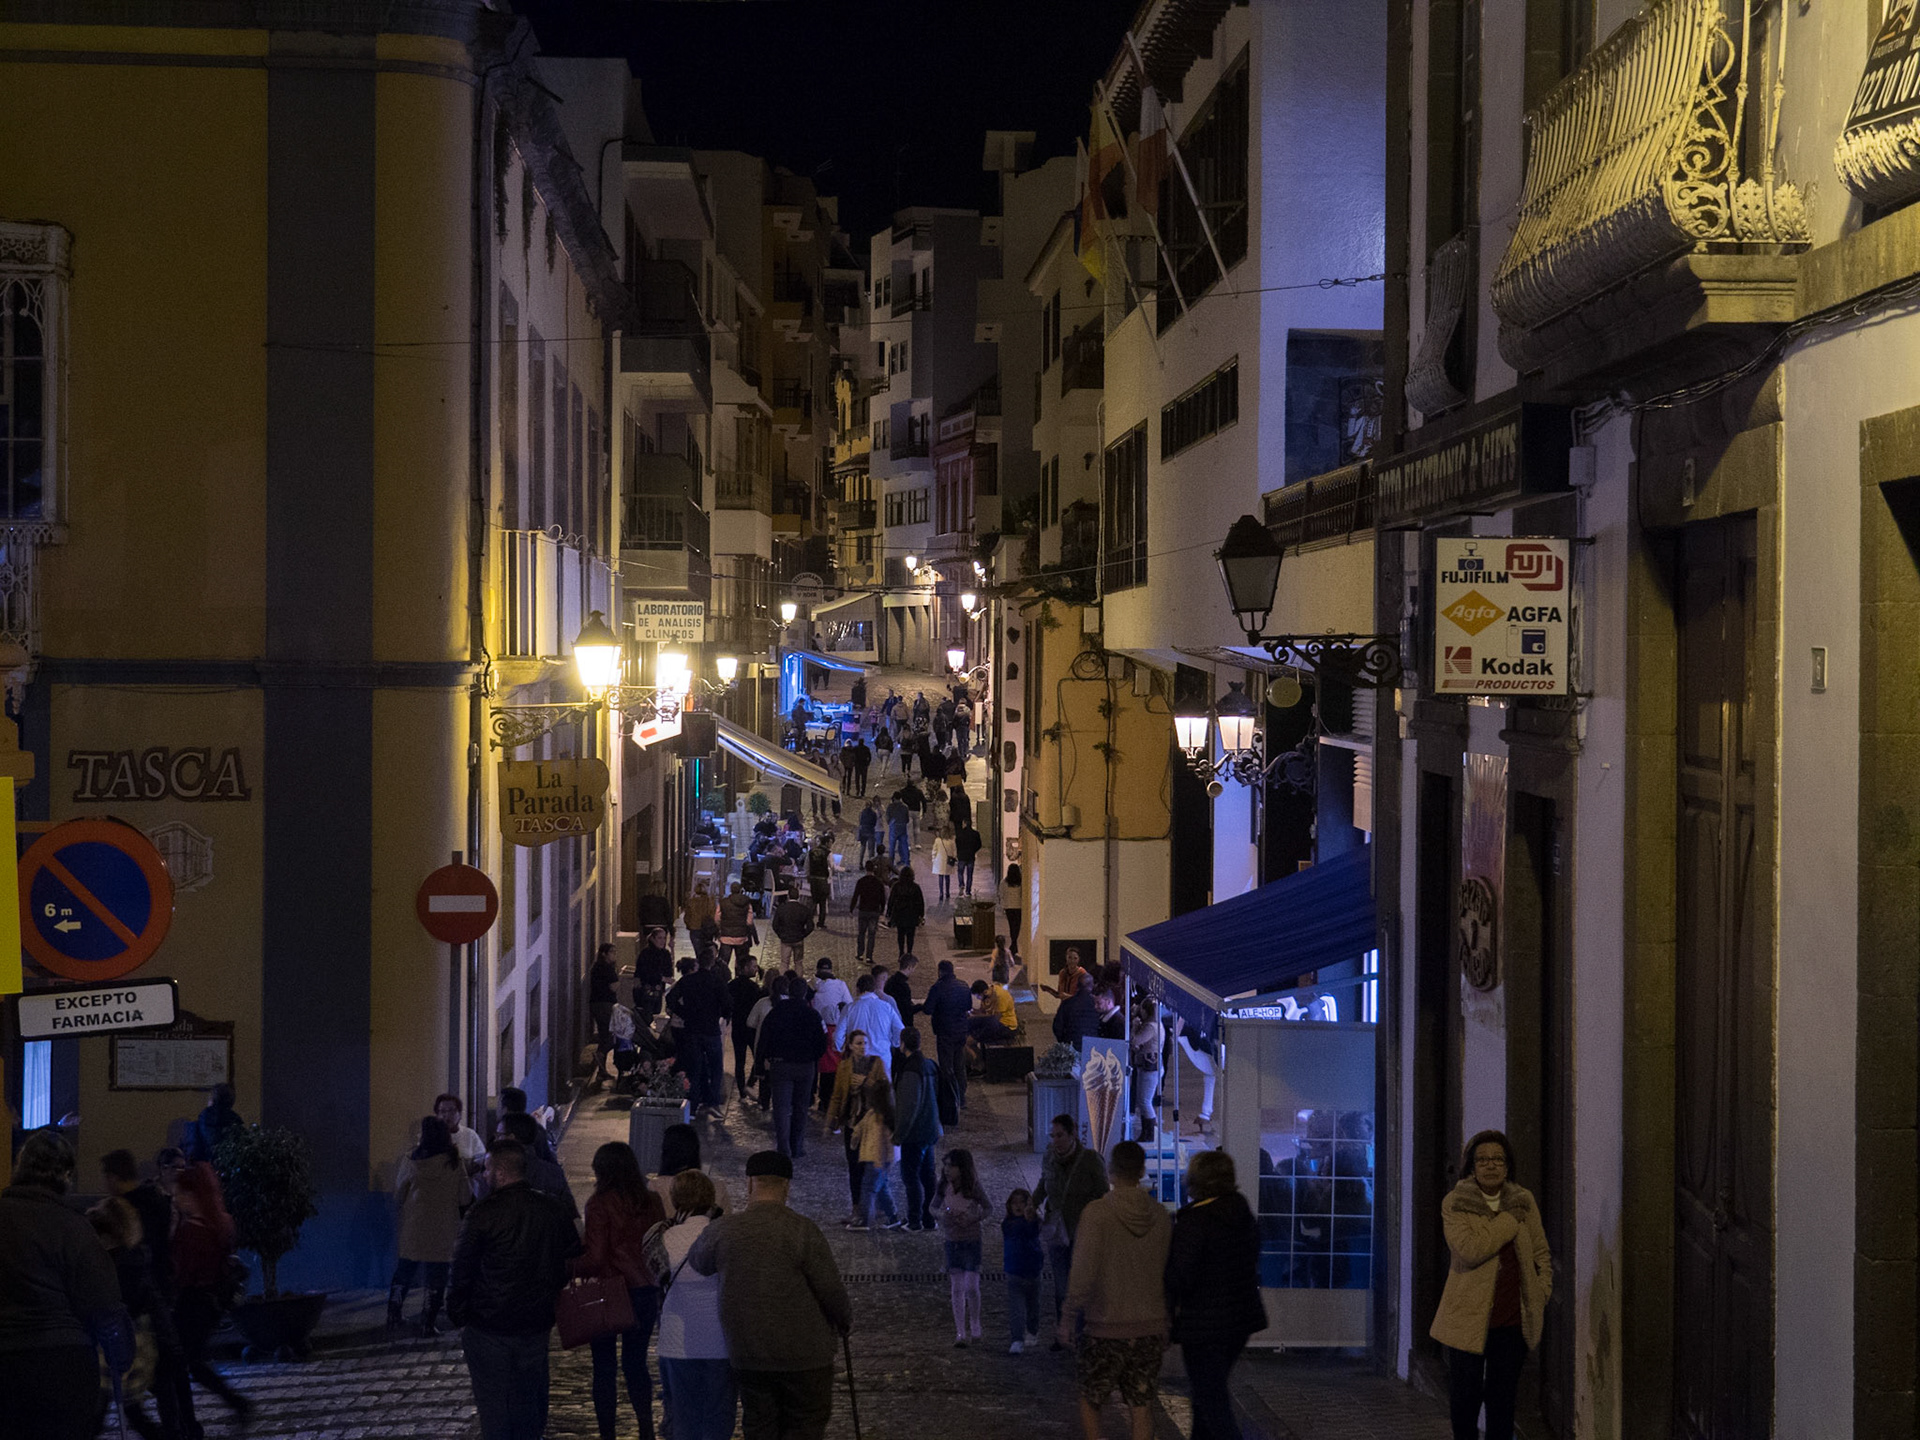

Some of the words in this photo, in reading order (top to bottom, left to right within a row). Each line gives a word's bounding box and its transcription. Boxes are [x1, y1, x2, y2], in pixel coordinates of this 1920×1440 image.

[1850, 67, 1885, 121] 922
[1875, 59, 1902, 111] 10
[1893, 50, 1920, 106] 10
[1378, 466, 1402, 517] FOTO
[1404, 442, 1466, 511] ELECTRONIC
[1469, 437, 1479, 495] &
[1481, 422, 1517, 489] GIFTS
[1441, 571, 1510, 584] FUJIFILM
[637, 604, 703, 616] LABORATORIO
[1449, 605, 1498, 622] Agfa
[1507, 606, 1562, 622] AGFA
[638, 618, 649, 627] DE
[658, 618, 702, 628] ANALISIS
[645, 629, 694, 639] CLINICOS
[1482, 658, 1553, 675] Kodak
[1475, 679, 1556, 690] PRODUCTOS
[70, 749, 248, 801] TASCA
[536, 765, 563, 789] La
[507, 785, 595, 815] Parada
[514, 816, 585, 833] TASCA
[44, 902, 57, 918] 6
[60, 908, 73, 916] m
[55, 991, 137, 1010] EXCEPTO
[52, 1009, 144, 1030] FARMACIA
[1240, 1005, 1281, 1017] ALE-HOP
